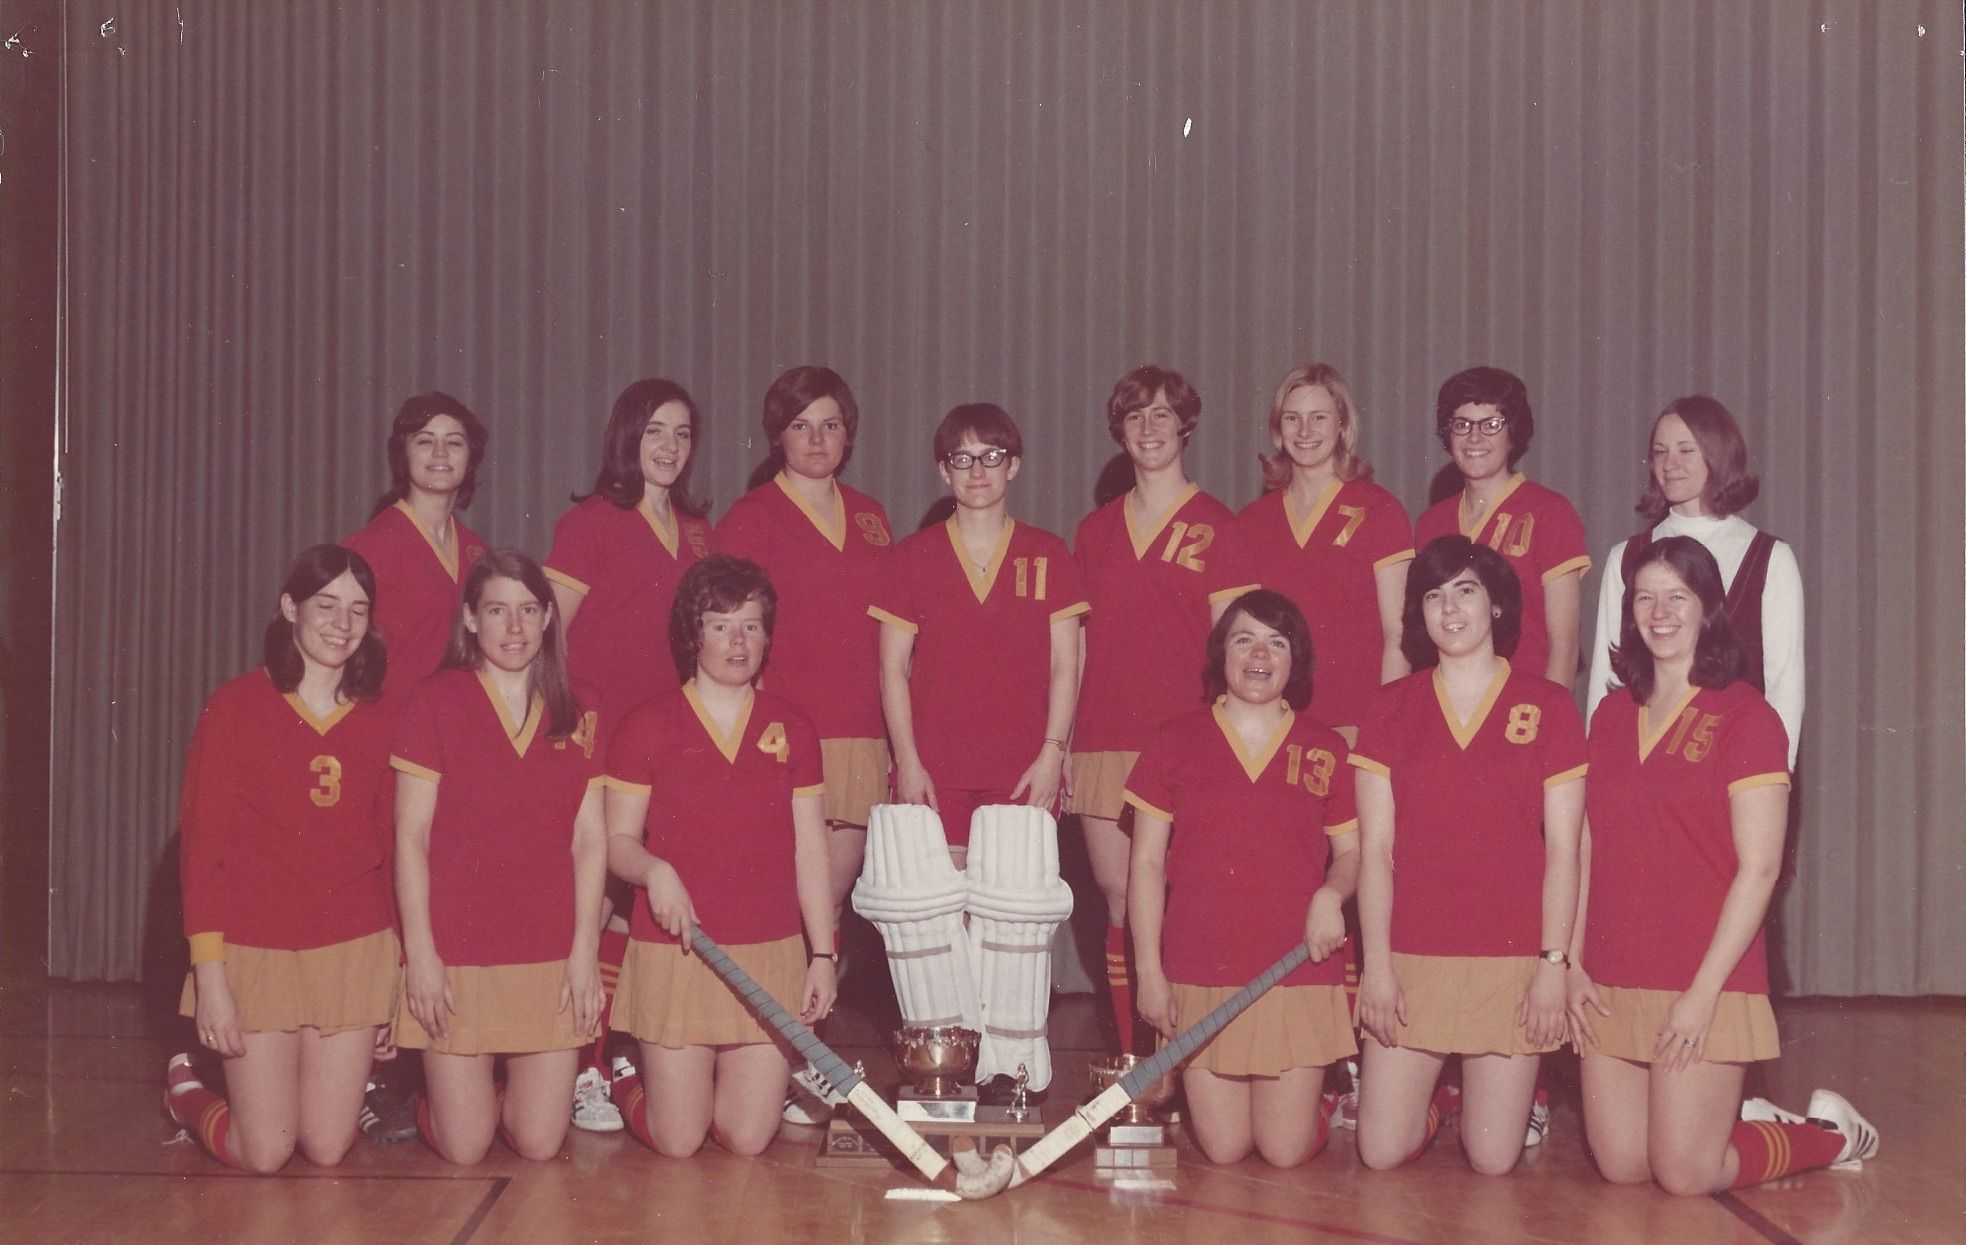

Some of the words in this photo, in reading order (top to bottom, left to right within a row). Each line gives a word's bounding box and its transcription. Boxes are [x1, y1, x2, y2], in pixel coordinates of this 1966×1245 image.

[854, 512, 890, 546] 9
[1160, 521, 1215, 572] 12
[1333, 504, 1366, 547] 7
[1488, 511, 1535, 557] 10
[1013, 556, 1048, 600] 11
[554, 710, 598, 760] 4
[756, 721, 790, 763] 4
[1504, 703, 1542, 745] 8
[1665, 706, 1724, 763] 15
[310, 754, 342, 807] 3
[1286, 743, 1336, 796] 13
